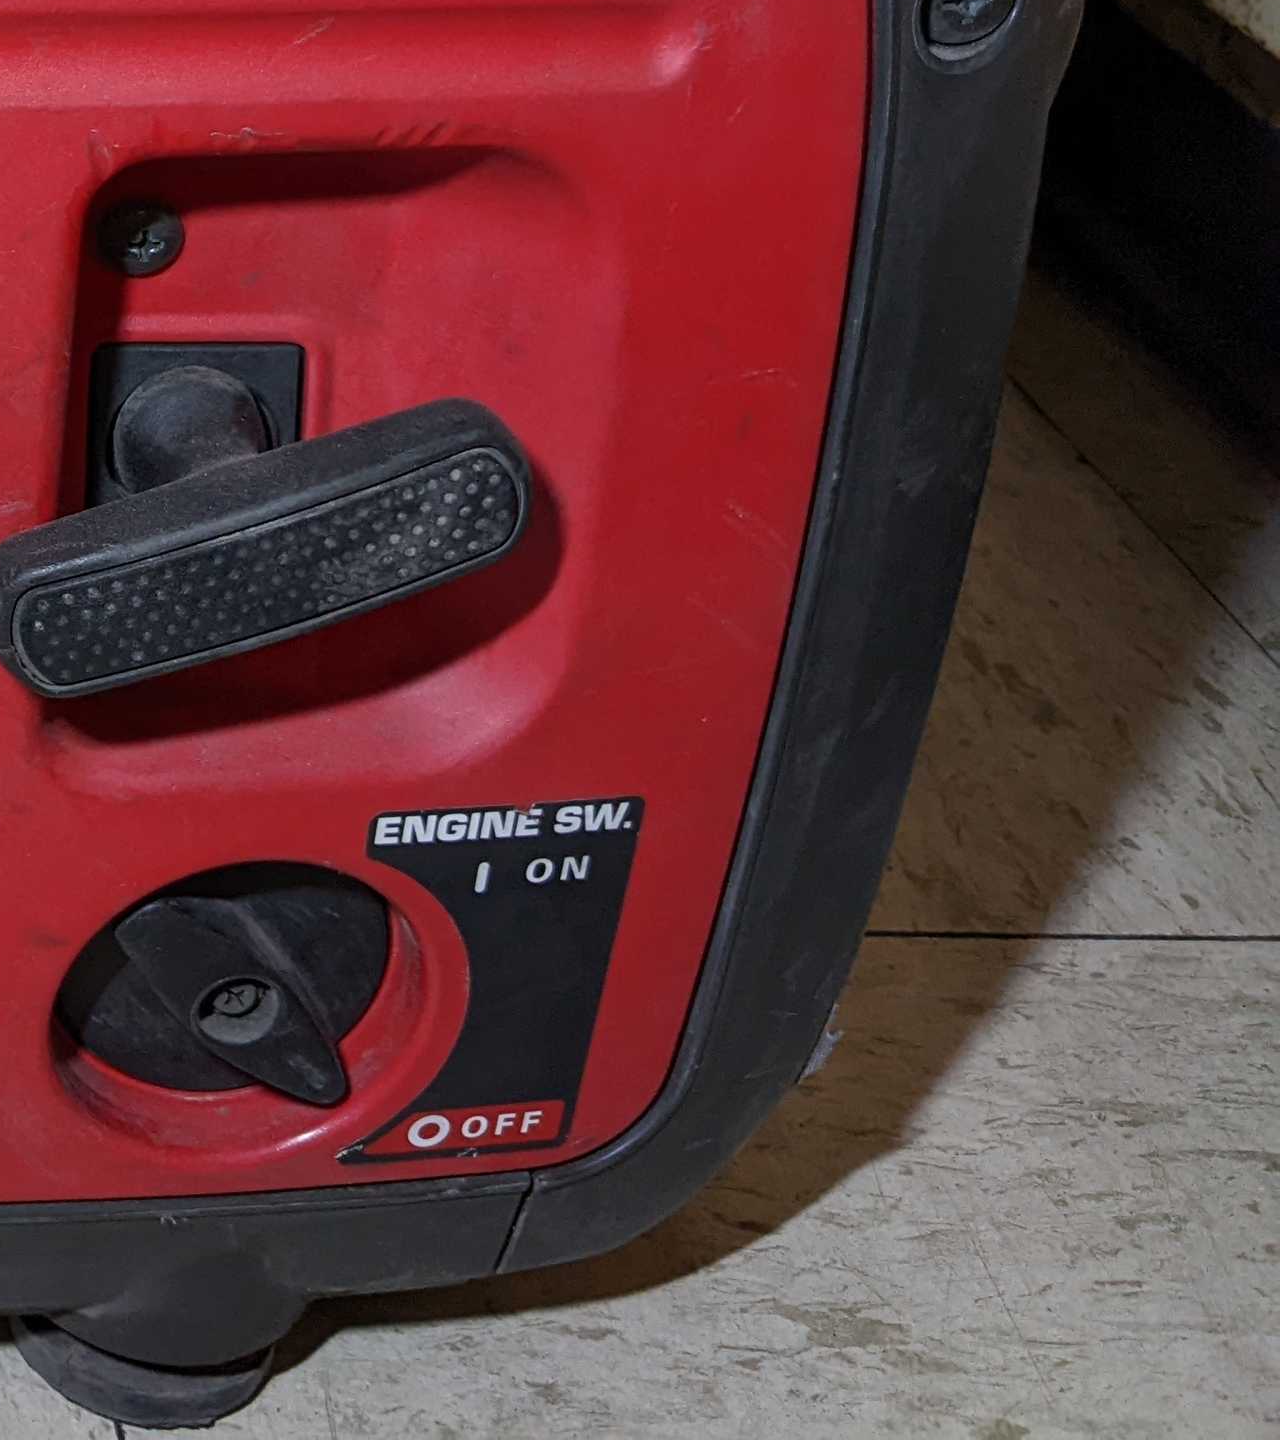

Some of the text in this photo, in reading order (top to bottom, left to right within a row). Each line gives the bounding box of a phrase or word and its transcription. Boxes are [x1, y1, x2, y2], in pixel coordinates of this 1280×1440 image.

[373, 801, 633, 846] ENGINE SW.
[525, 856, 591, 884] ON
[461, 1110, 542, 1140] OFF
